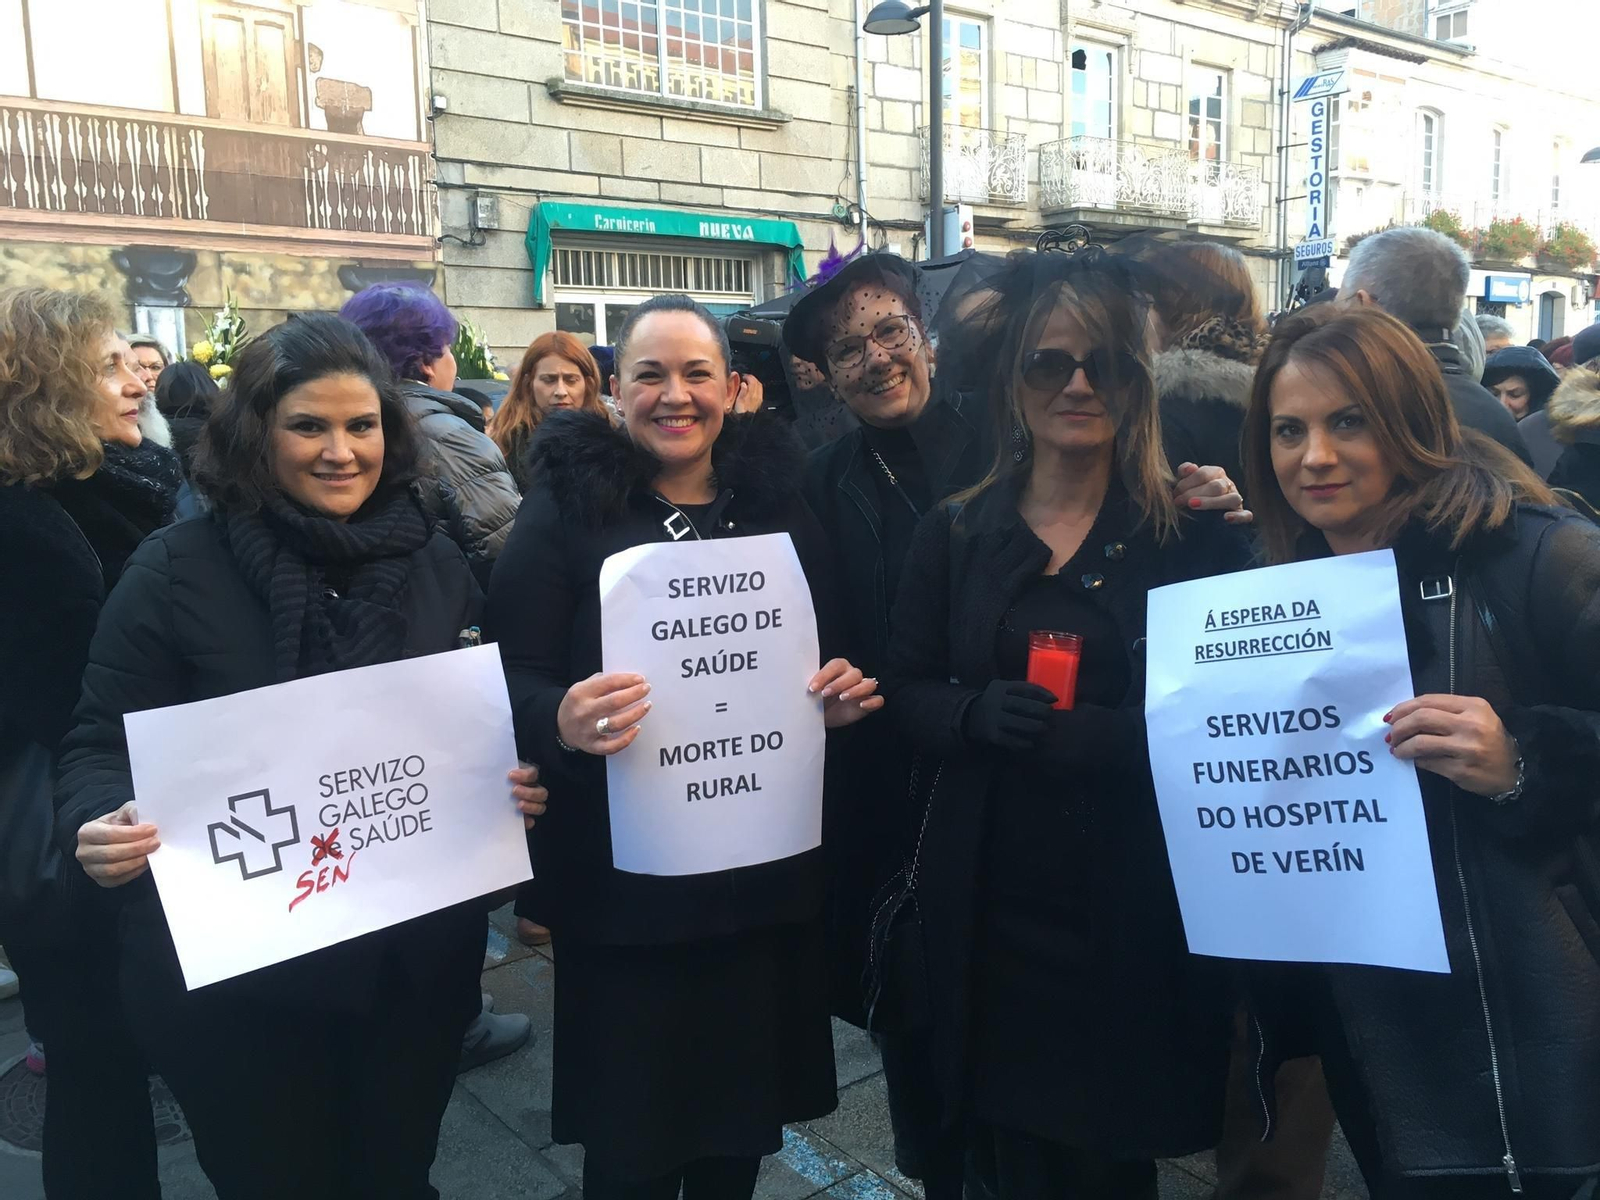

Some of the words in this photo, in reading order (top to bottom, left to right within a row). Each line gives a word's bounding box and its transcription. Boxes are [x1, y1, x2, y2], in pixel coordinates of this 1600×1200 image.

[1308, 101, 1324, 238] GESTORIA
[1295, 241, 1333, 258] SEGUROS
[668, 571, 766, 599] SERVIZO
[651, 612, 748, 641] GALEGO
[754, 608, 783, 631] DE
[1204, 610, 1218, 630] Á
[1221, 603, 1287, 627] ESPERA
[1292, 599, 1321, 618] DA
[1194, 628, 1333, 661] RESURRECCIÓN
[680, 649, 758, 679] SAÚDE
[1206, 705, 1341, 739] SERVIZOS
[659, 736, 743, 767] MORTE
[750, 730, 784, 753] DO
[318, 754, 425, 798] SERVIZO
[1192, 750, 1375, 785] FUNERARIOS
[686, 772, 762, 802] RURAL
[318, 782, 429, 828] GALEGO
[1197, 806, 1236, 829] DO
[1243, 798, 1388, 829] HOSPITAL
[349, 809, 433, 851] SAÚDE
[1231, 850, 1267, 875] DE
[1272, 842, 1366, 875] VERÍN
[288, 851, 357, 914] SEN
